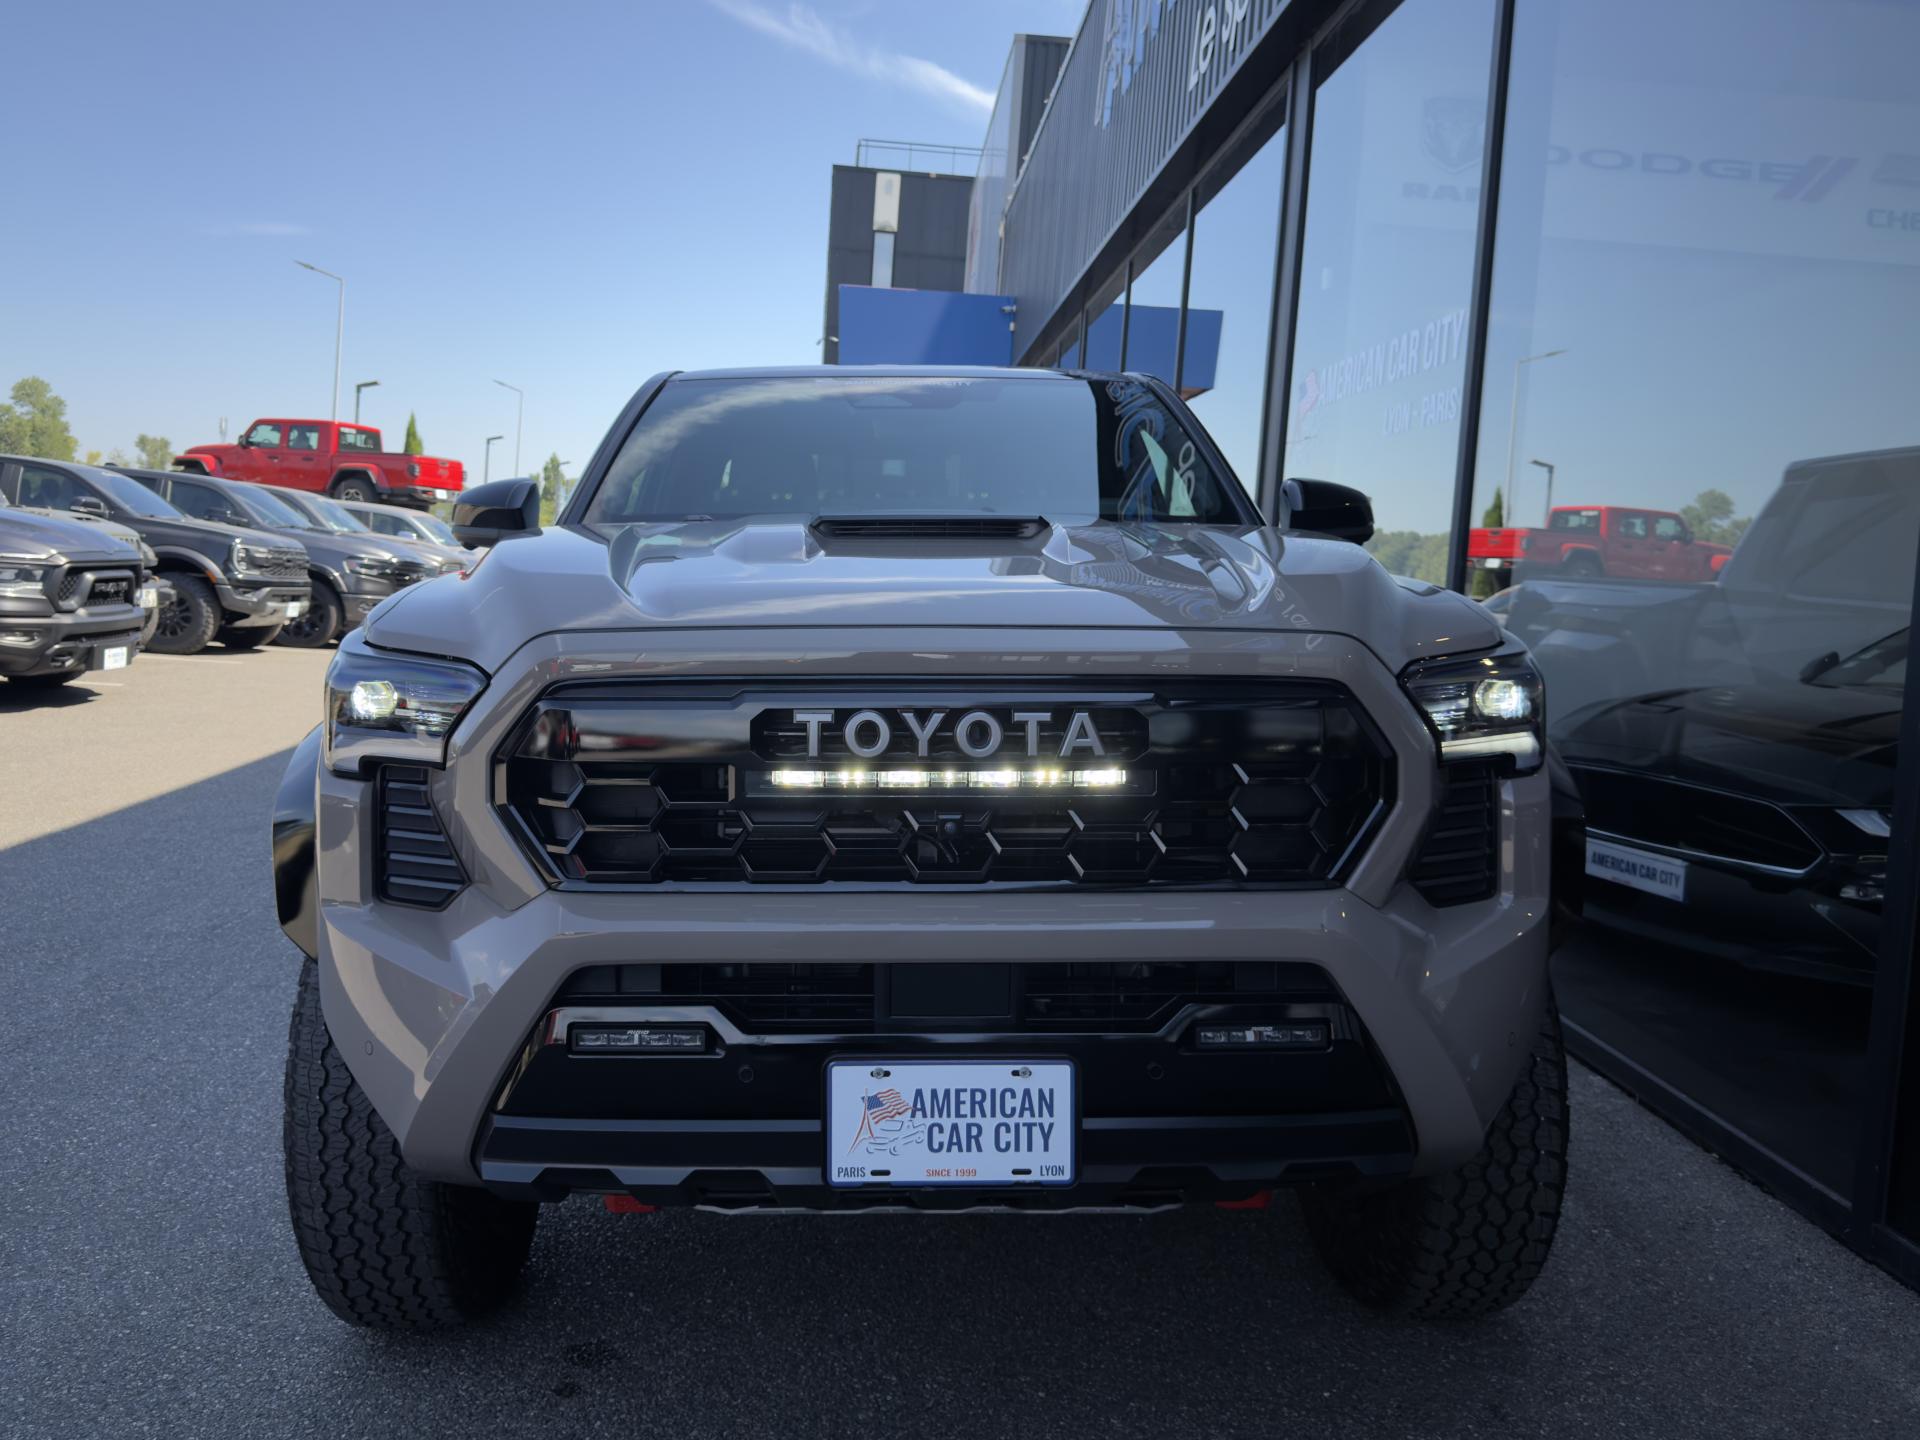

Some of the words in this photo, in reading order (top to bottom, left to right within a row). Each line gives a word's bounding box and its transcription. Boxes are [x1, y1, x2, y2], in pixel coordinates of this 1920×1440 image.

[1317, 342, 1386, 407] AMERICAN
[1387, 328, 1420, 383] CAR
[1422, 309, 1466, 371] CITY
[1383, 400, 1411, 437] LYON
[1420, 387, 1459, 428] PARIS
[794, 709, 1105, 758] TOYOTA
[1591, 850, 1639, 877] AMERICAN
[1638, 863, 1658, 882] CAR
[1659, 870, 1681, 889] CITY
[910, 1087, 1055, 1119] AMERICAN
[927, 1122, 983, 1154] CAR
[994, 1122, 1054, 1153] CITY
[837, 1166, 866, 1178] PARIS
[925, 1168, 952, 1177] SINCE
[955, 1168, 977, 1177] 1999
[1040, 1164, 1065, 1177] LYON
